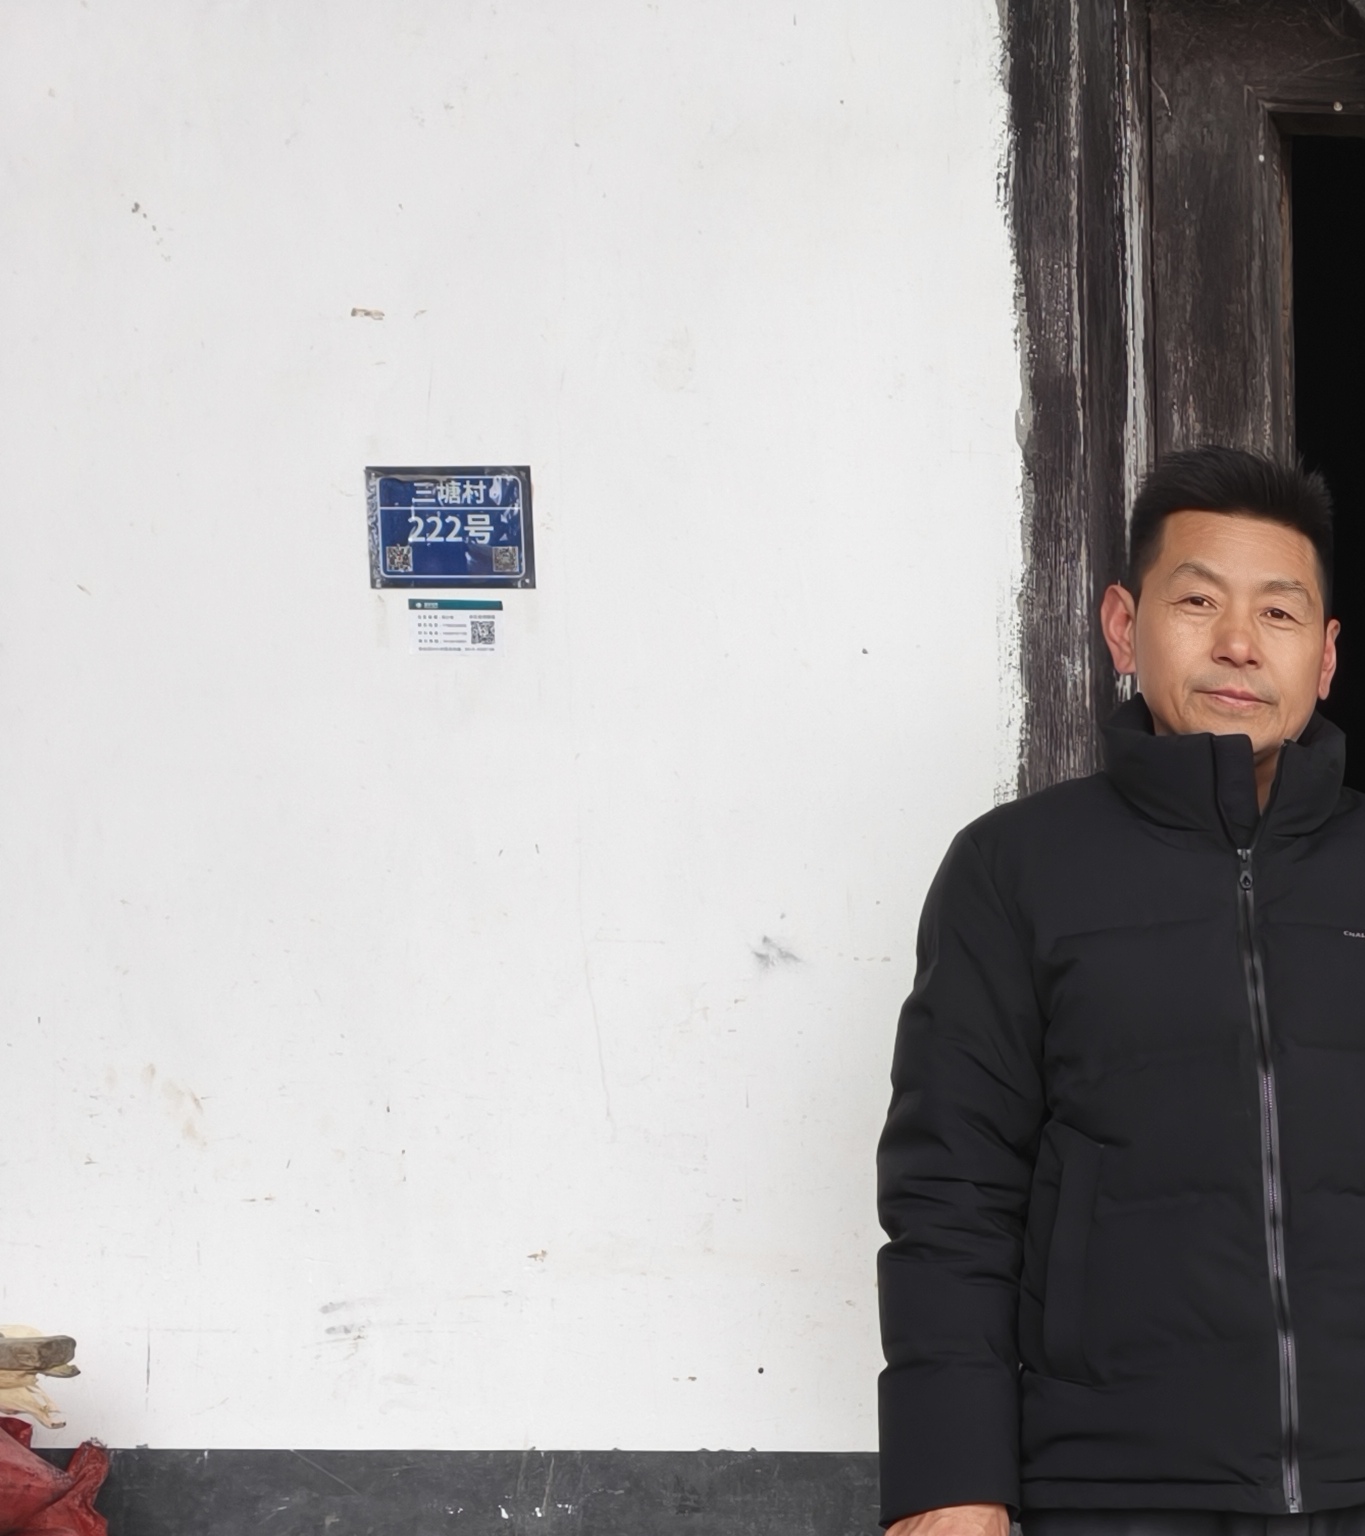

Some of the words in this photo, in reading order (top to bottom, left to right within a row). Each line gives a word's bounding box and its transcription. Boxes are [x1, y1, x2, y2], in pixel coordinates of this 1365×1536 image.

[411, 480, 486, 505] 三塘村
[408, 514, 494, 545] 222号
